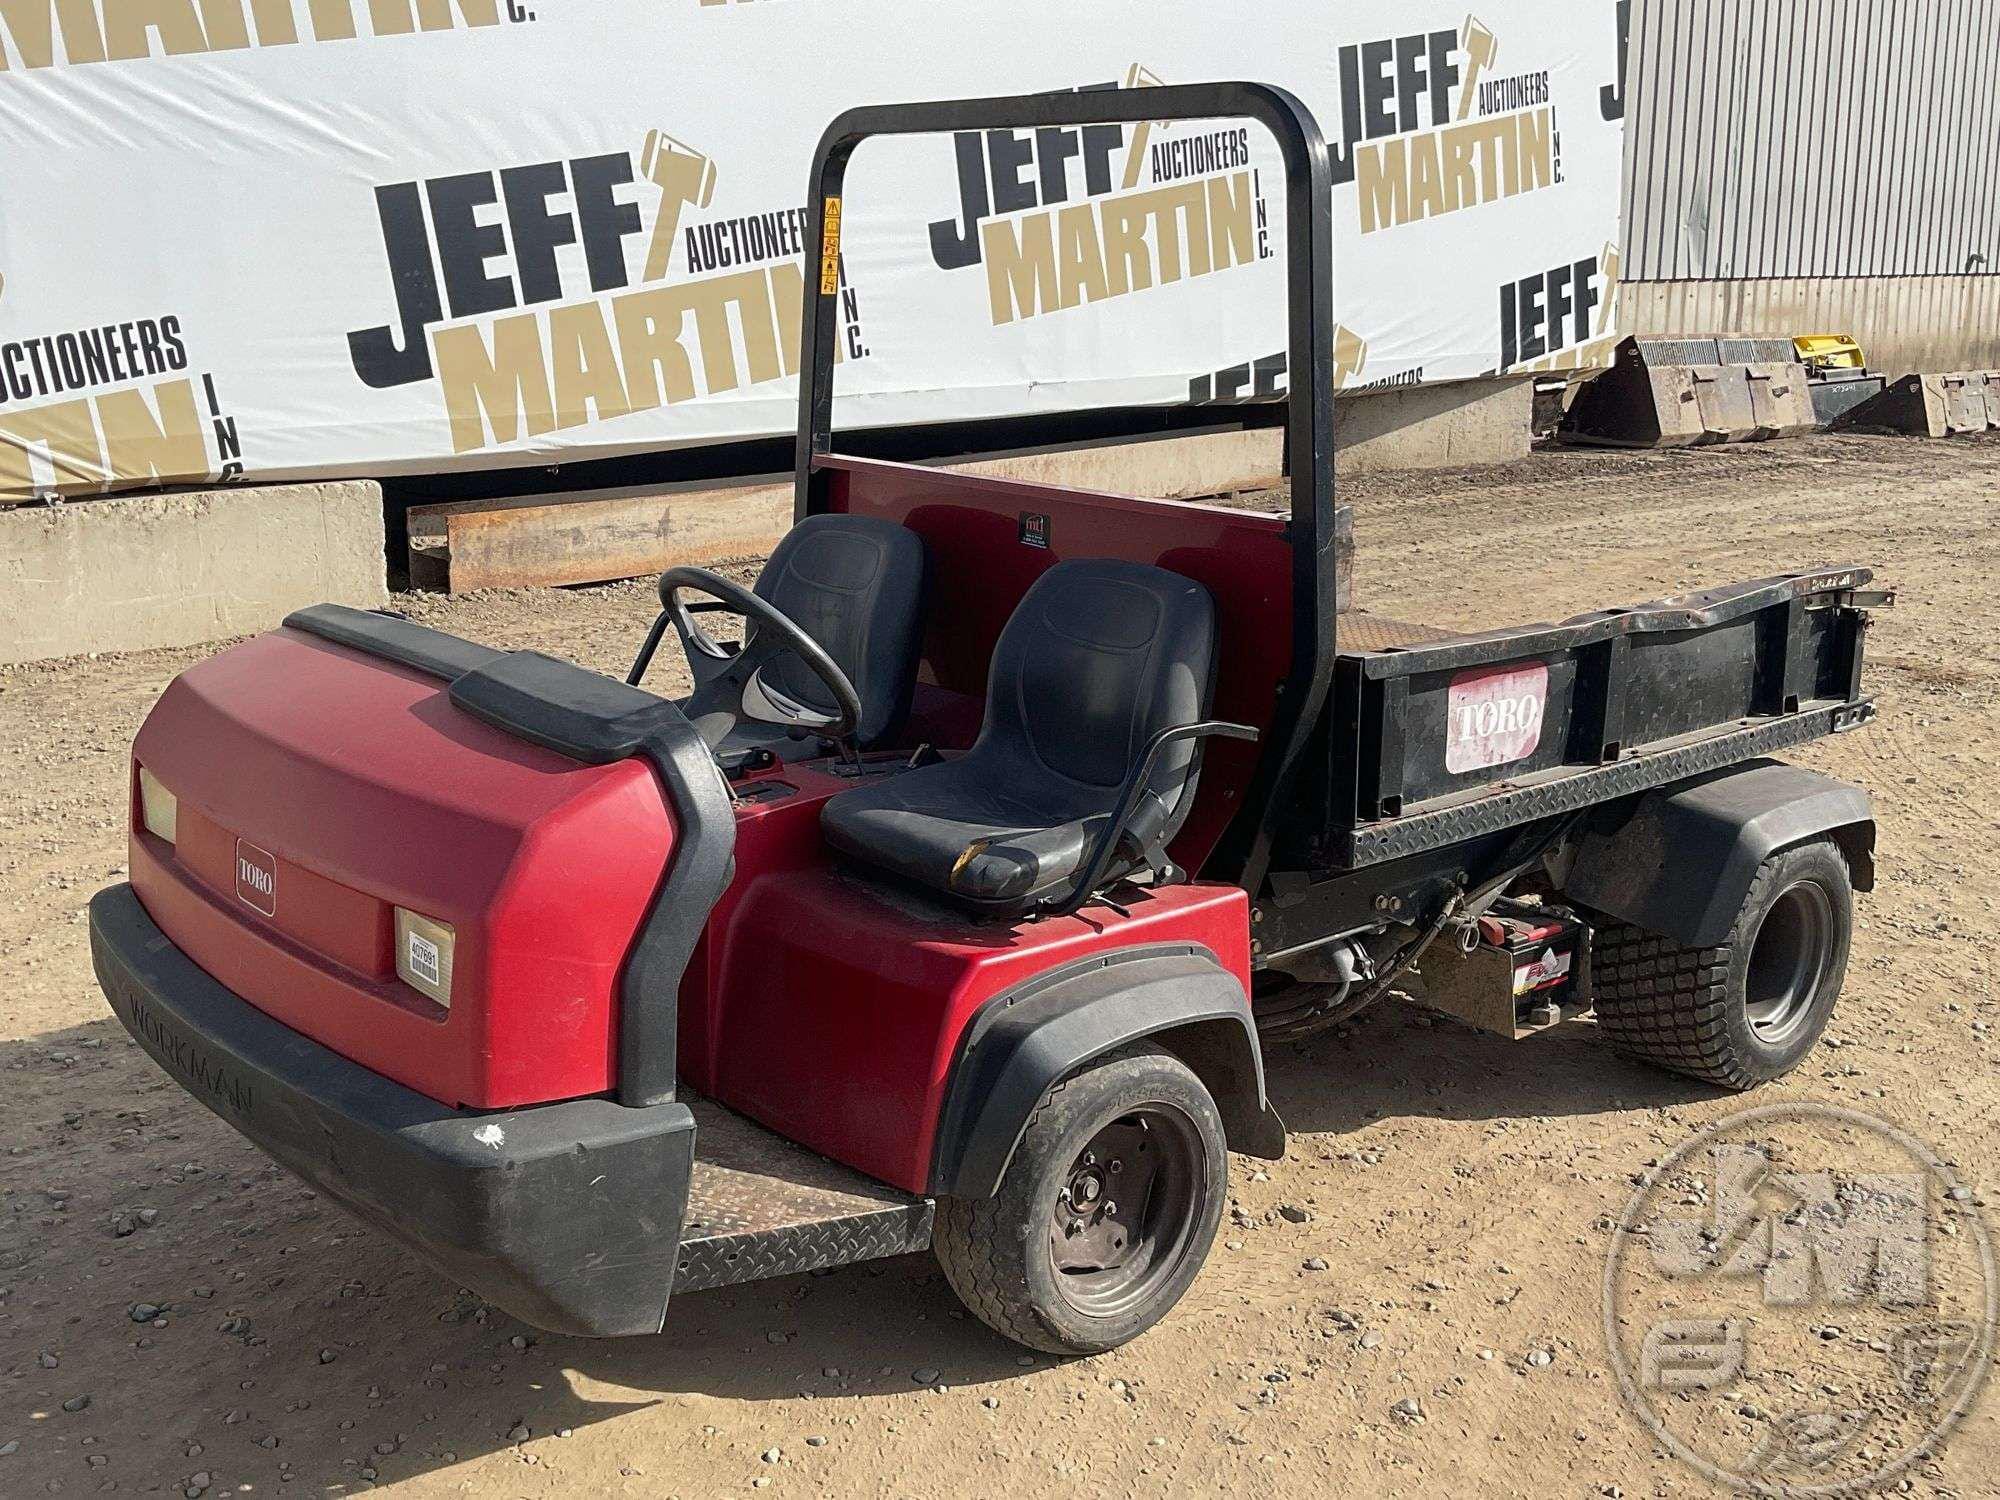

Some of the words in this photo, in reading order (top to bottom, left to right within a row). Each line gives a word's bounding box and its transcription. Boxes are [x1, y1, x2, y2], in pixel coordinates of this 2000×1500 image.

[1327, 29, 1459, 184] JEFF
[1479, 71, 1549, 116] AUCTIONEERS
[928, 82, 1123, 270] JEFF
[1152, 128, 1249, 183] AUCTIONEERS
[1356, 108, 1551, 234] MARTIN
[347, 151, 642, 389] JEFF
[982, 171, 1255, 326] MARTIN
[1456, 694, 1538, 741] TORO
[240, 857, 273, 895] TORO
[129, 991, 252, 1112] WORKMAN
